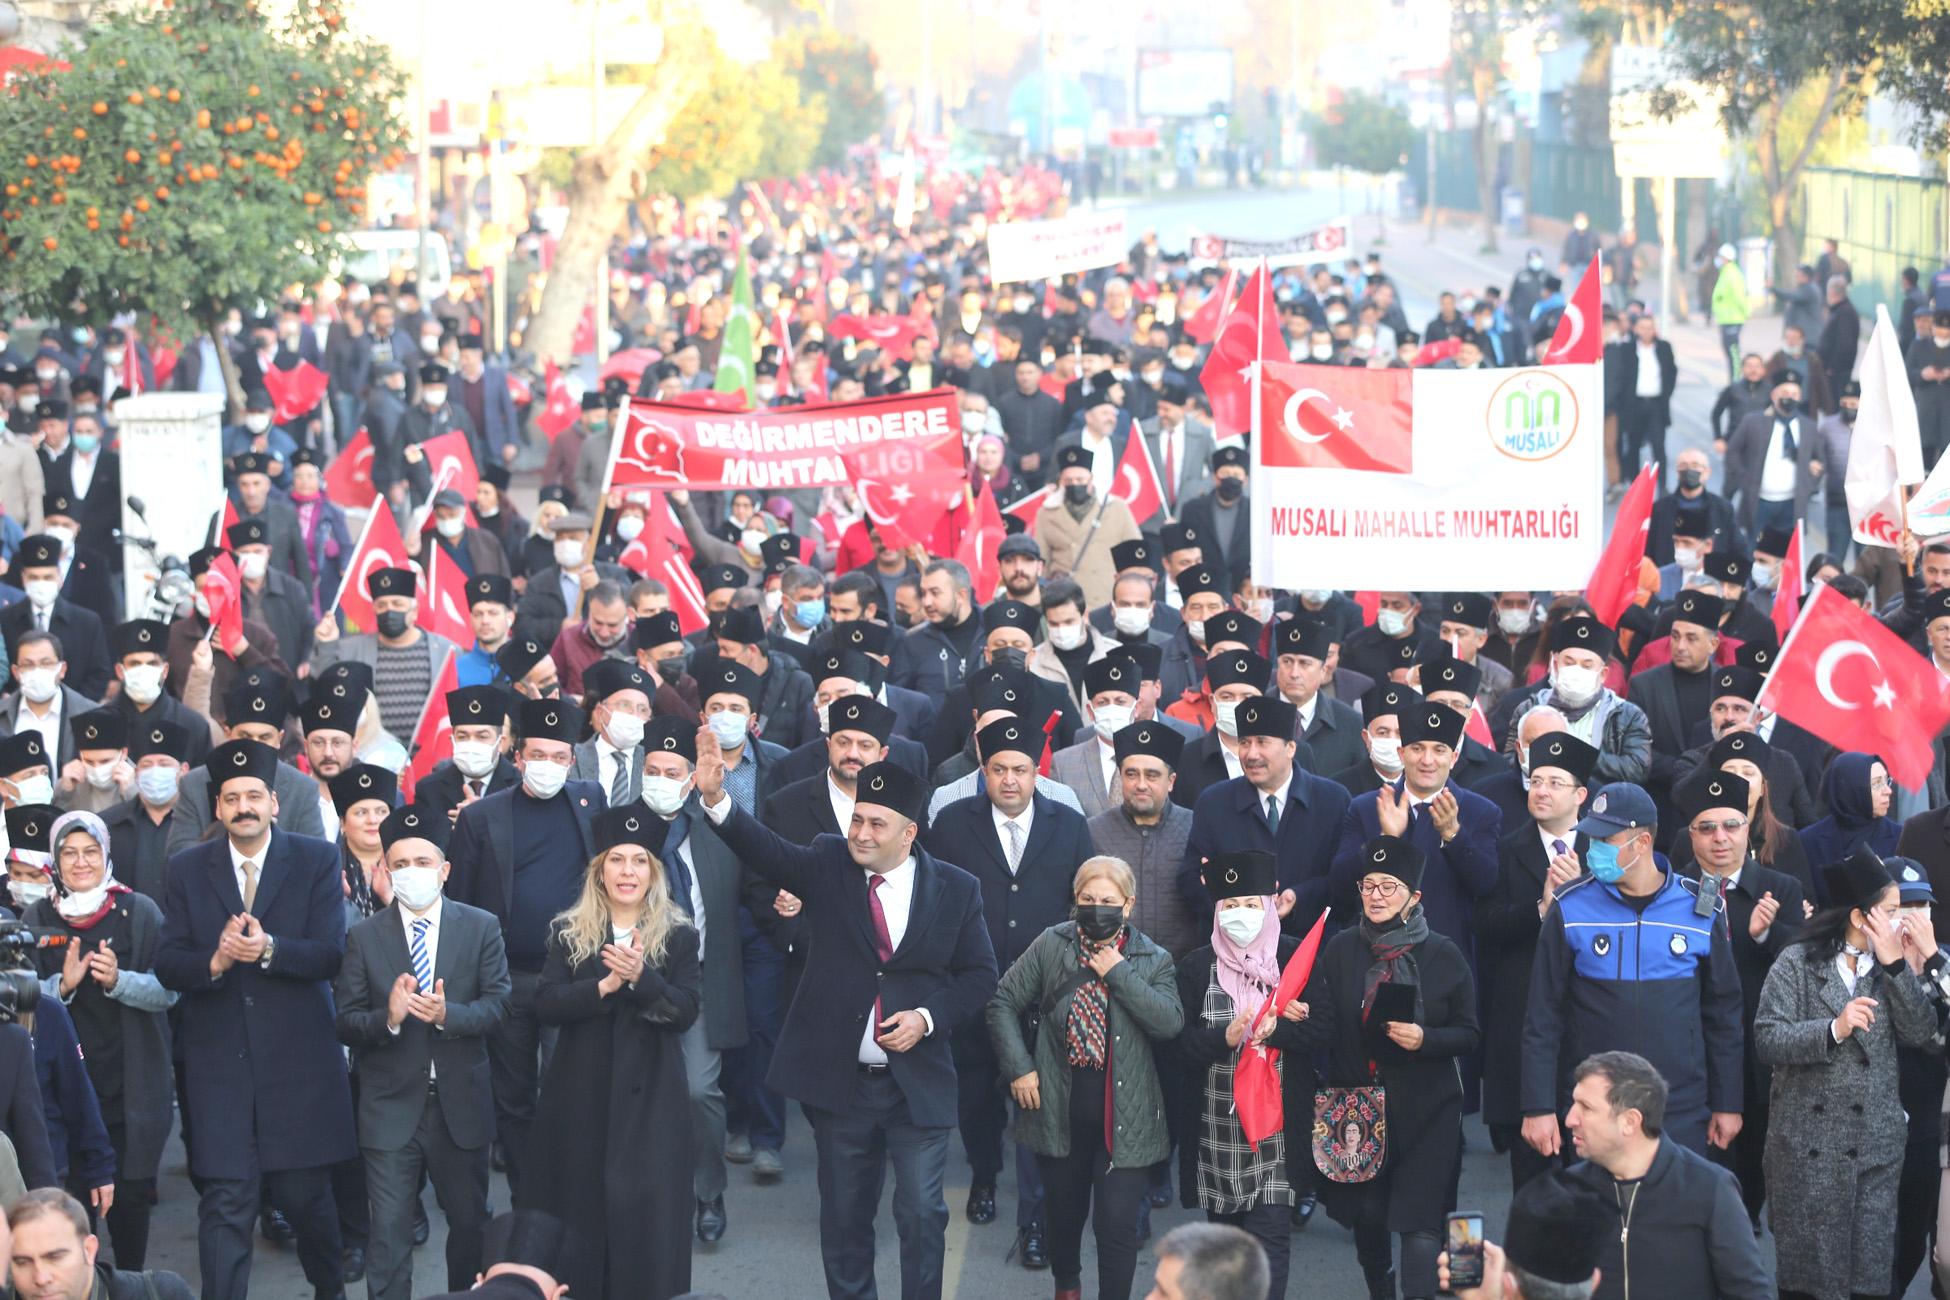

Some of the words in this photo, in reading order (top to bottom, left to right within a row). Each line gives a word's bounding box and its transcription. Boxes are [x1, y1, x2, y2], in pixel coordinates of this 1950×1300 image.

[695, 407, 949, 452] DEĞİRMENDERE
[1505, 431, 1559, 452] MUSALI
[1272, 507, 1347, 537] MUSALI
[1355, 509, 1446, 538] MAHALLE
[1454, 502, 1578, 539] MUHTARLIĞI
